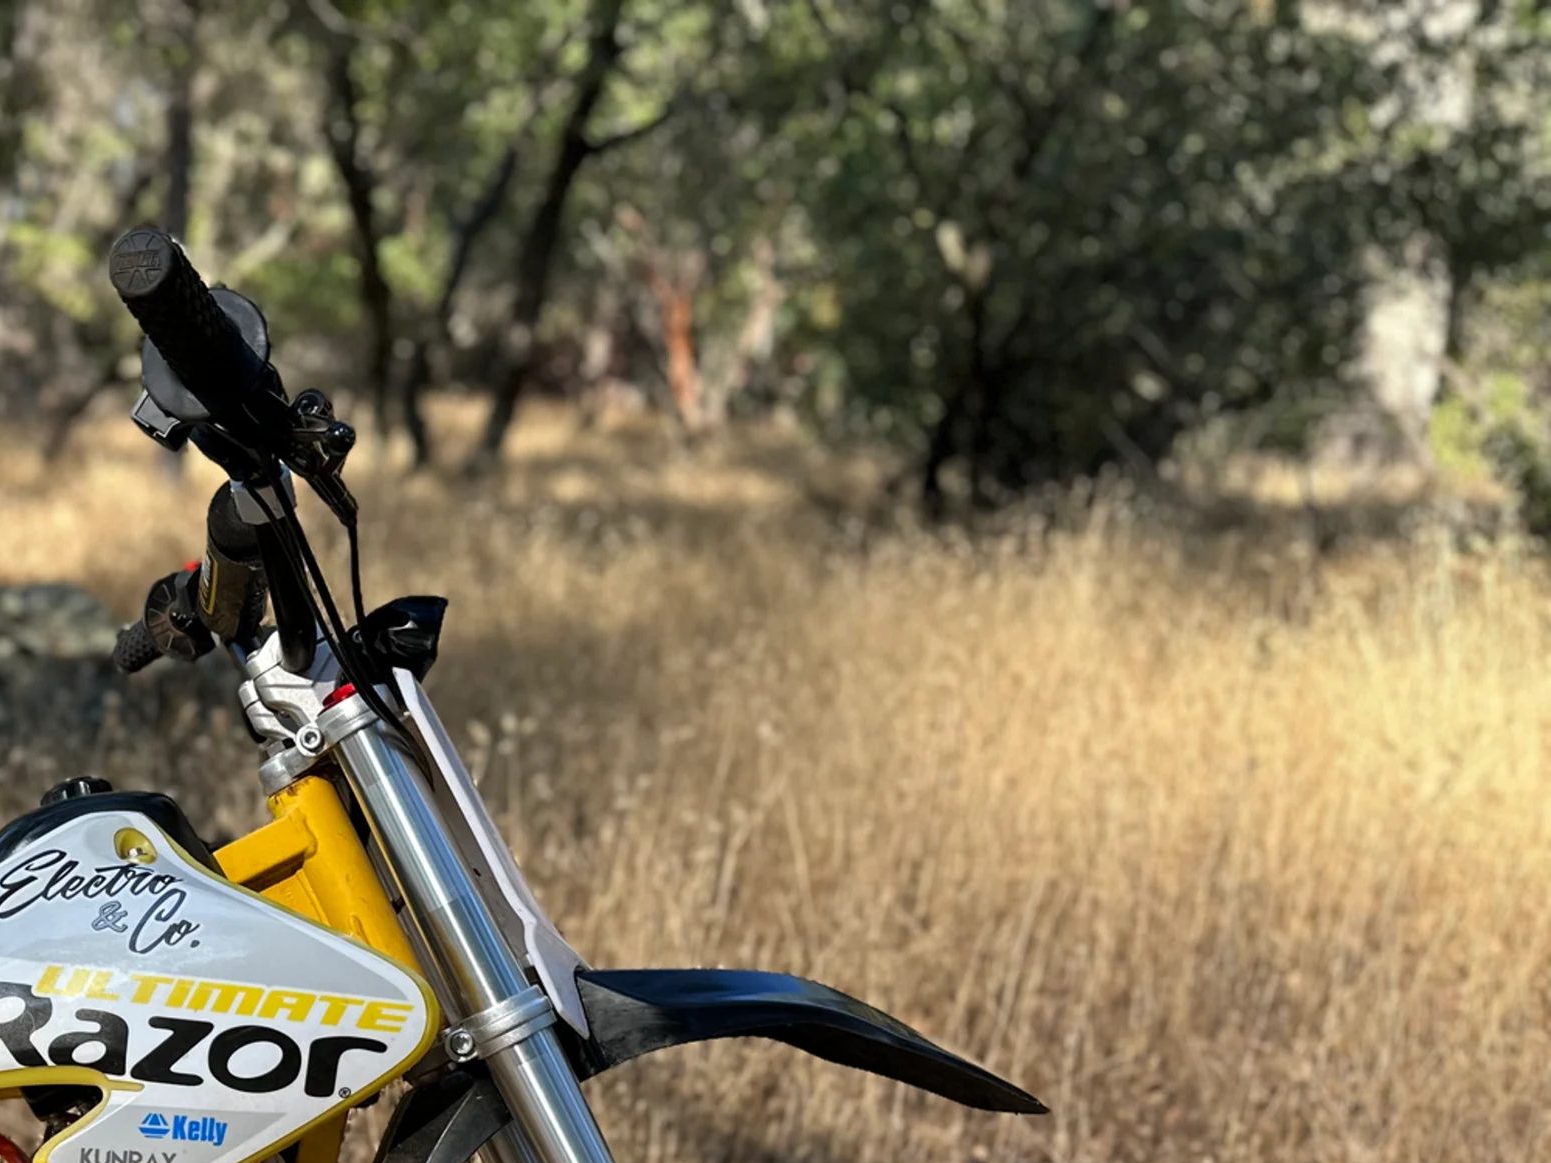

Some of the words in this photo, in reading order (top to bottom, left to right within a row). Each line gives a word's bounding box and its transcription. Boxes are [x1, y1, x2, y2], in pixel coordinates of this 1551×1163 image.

[91, 900, 128, 933] &
[129, 888, 200, 954] Co.
[34, 965, 414, 1033] ULTIMATE
[172, 1115, 227, 1146] Kelly
